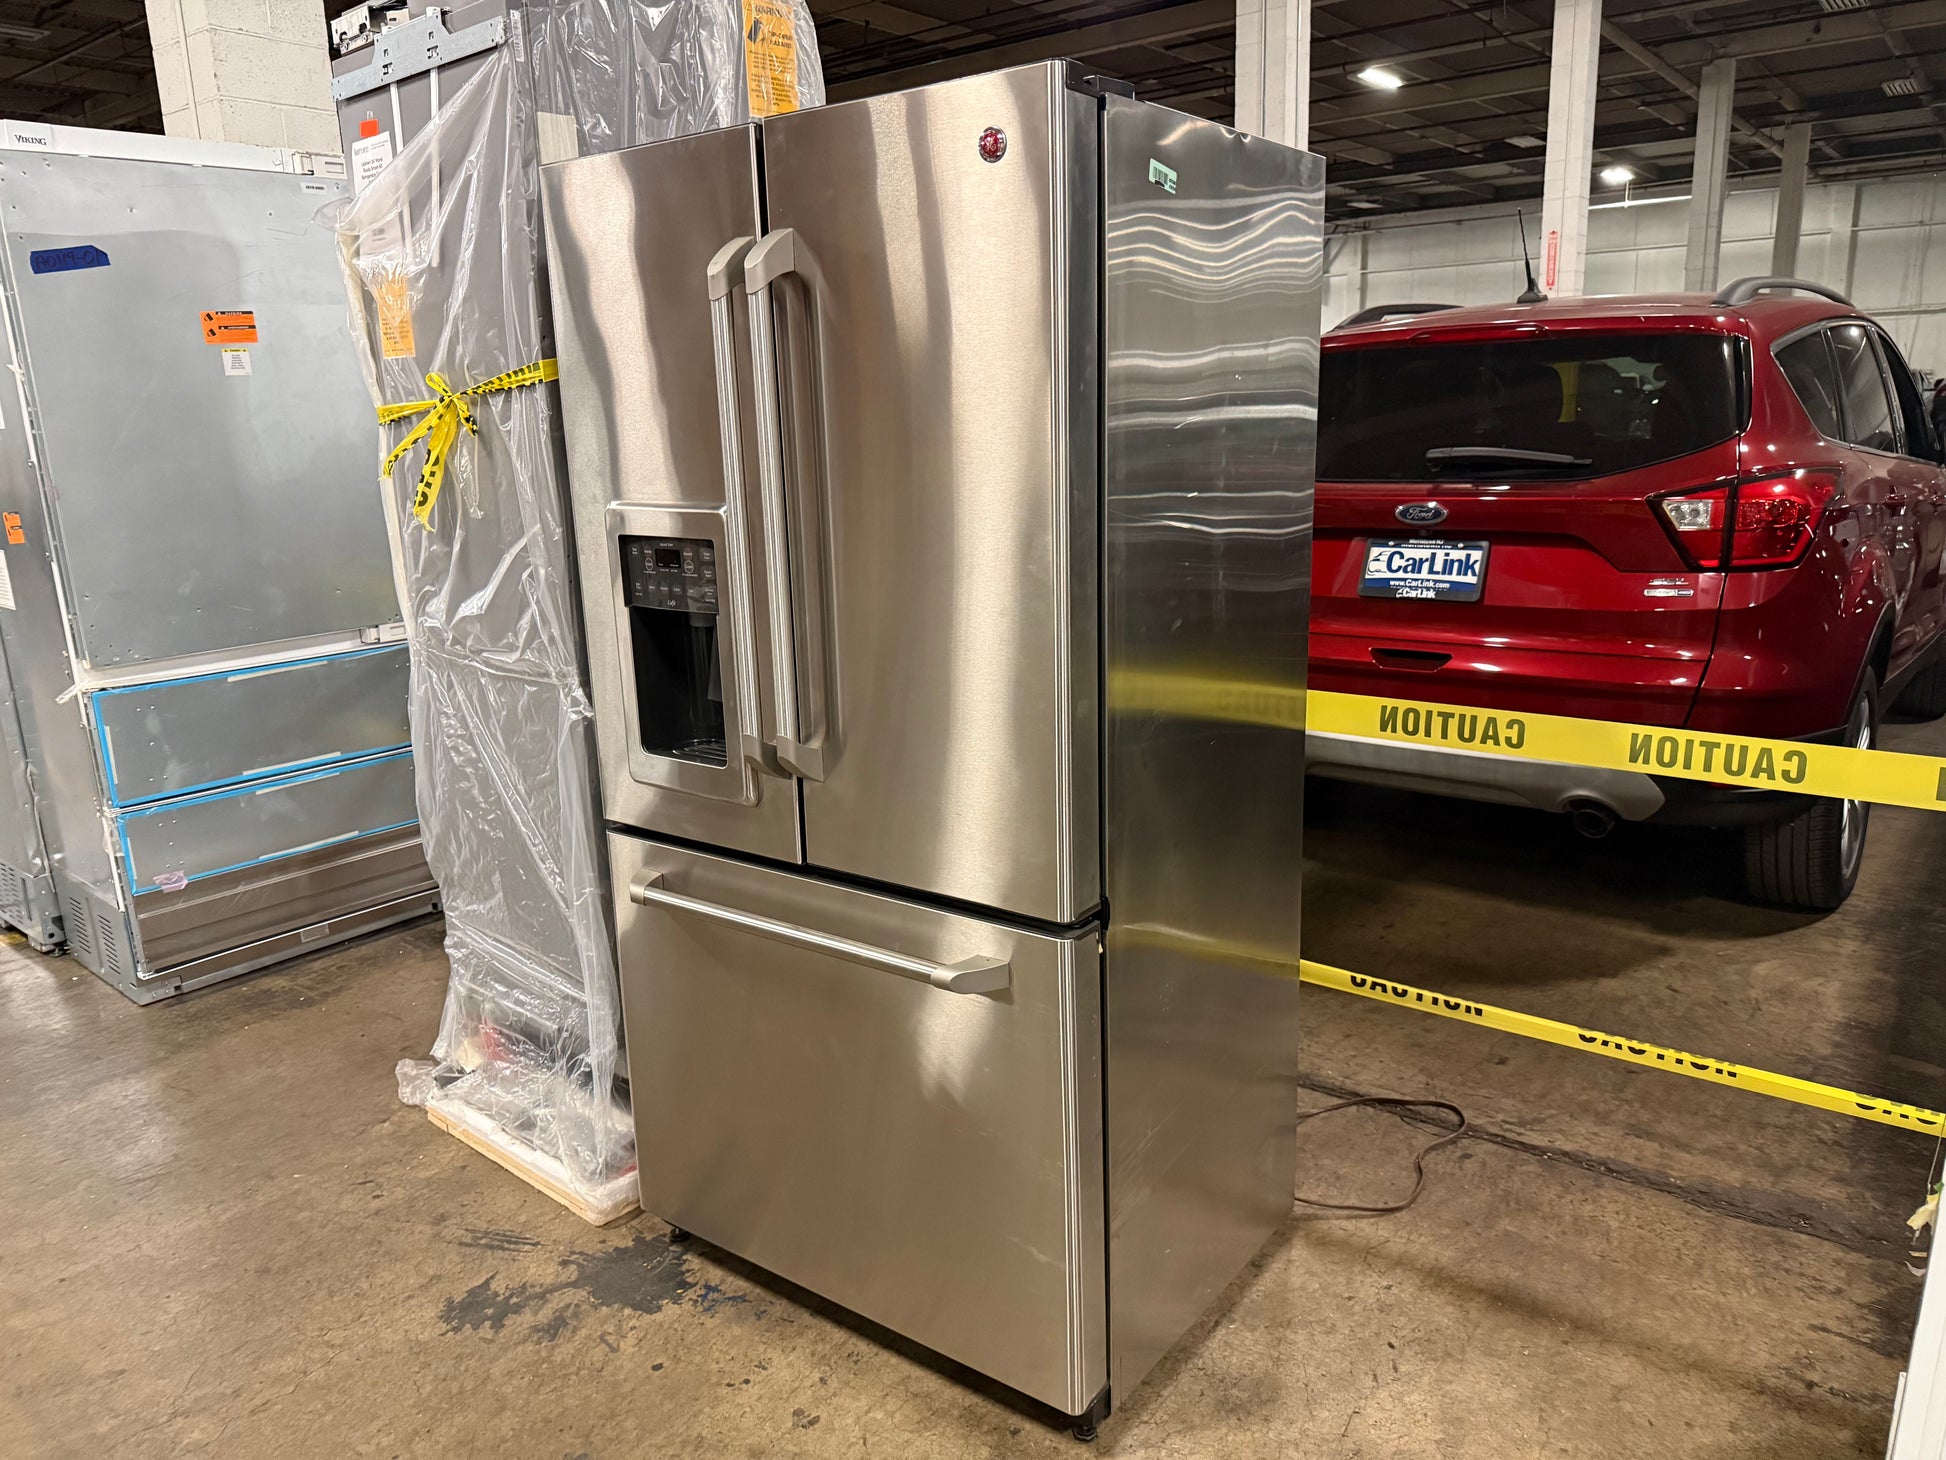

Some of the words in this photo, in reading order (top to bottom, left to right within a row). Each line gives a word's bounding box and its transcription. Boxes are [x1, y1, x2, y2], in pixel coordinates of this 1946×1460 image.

[14, 134, 47, 146] VIKING
[1406, 507, 1435, 519] Ford
[1386, 550, 1480, 577] CarLink
[1389, 579, 1450, 588] www.CarLink.com
[1402, 588, 1436, 598] CarLink
